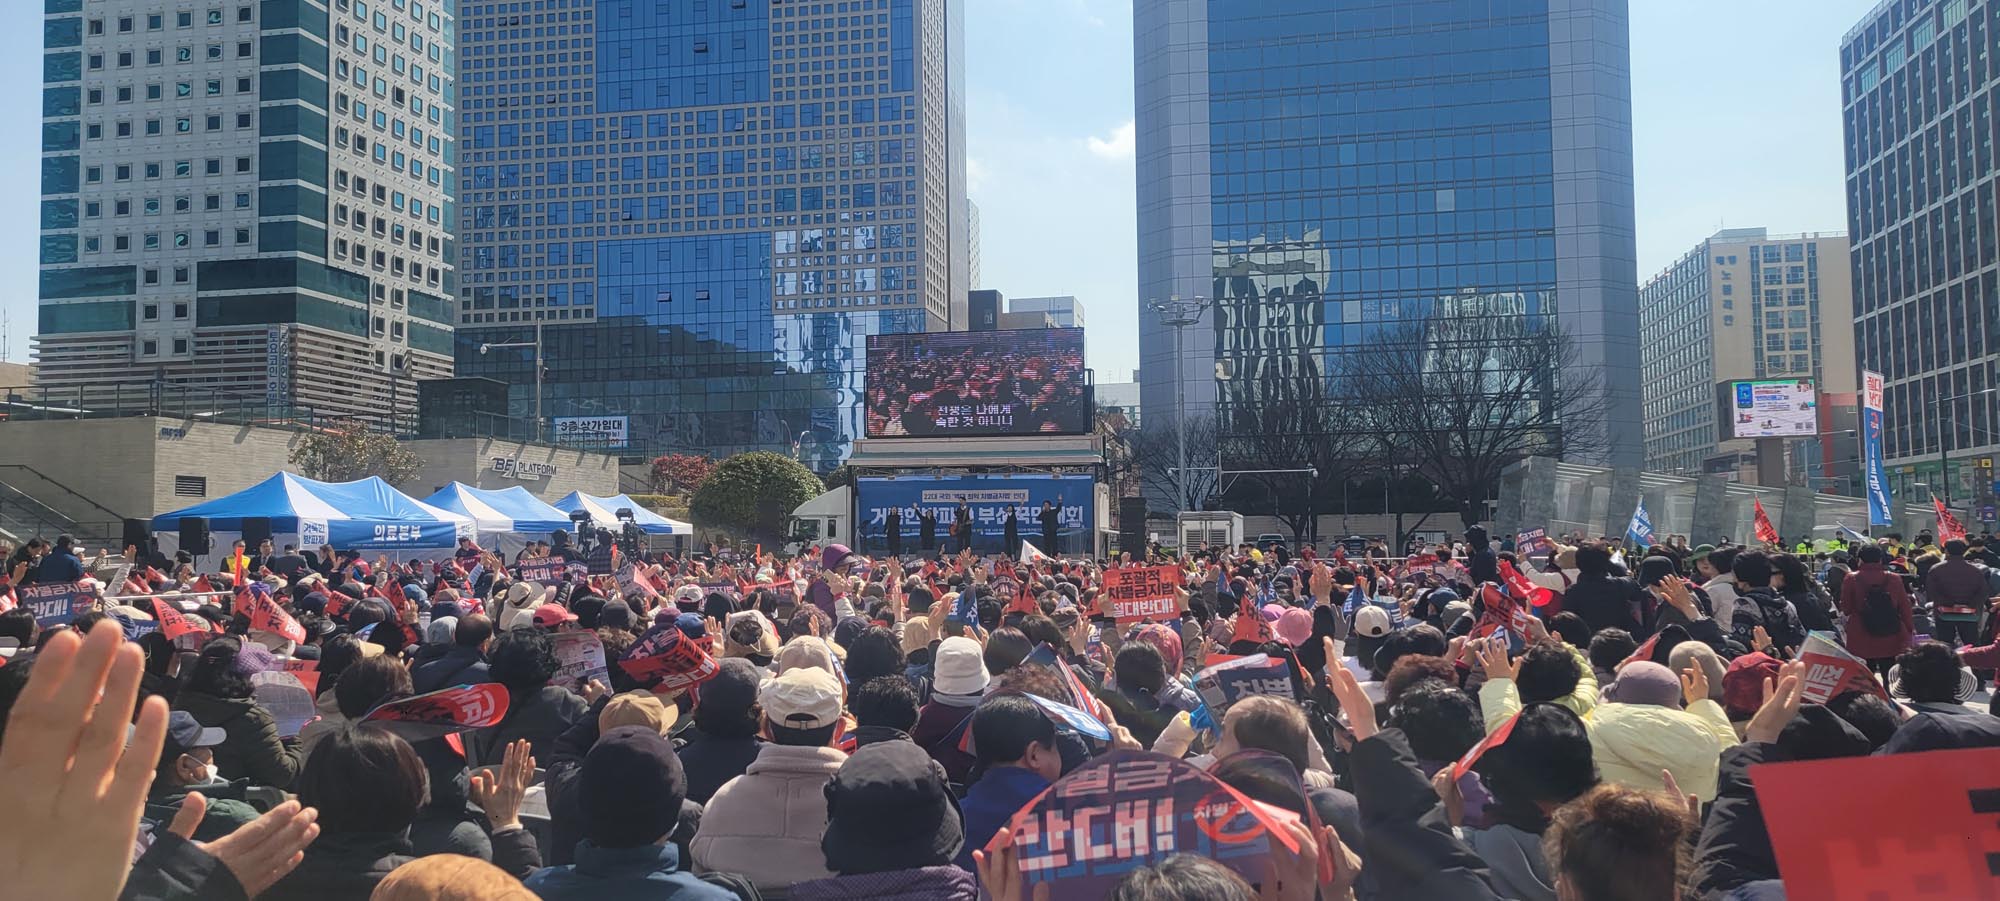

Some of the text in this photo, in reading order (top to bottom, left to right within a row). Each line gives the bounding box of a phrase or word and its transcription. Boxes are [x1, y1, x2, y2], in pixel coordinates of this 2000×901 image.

[938, 403, 1011, 416] 전쟁은 나에게
[580, 420, 623, 431] 상가임대
[936, 415, 1013, 428] 속한 것 아니니
[518, 462, 557, 476] PLATFORM
[374, 524, 422, 542] 의료본부
[521, 568, 551, 581] 반대!
[1120, 569, 1160, 585] 포괄적
[24, 581, 93, 598] 차별금지법
[1108, 582, 1174, 599] 차별금지법
[28, 598, 68, 619] 반대!
[1114, 598, 1174, 618] 절대반대!
[1015, 798, 1174, 872] 반대!
